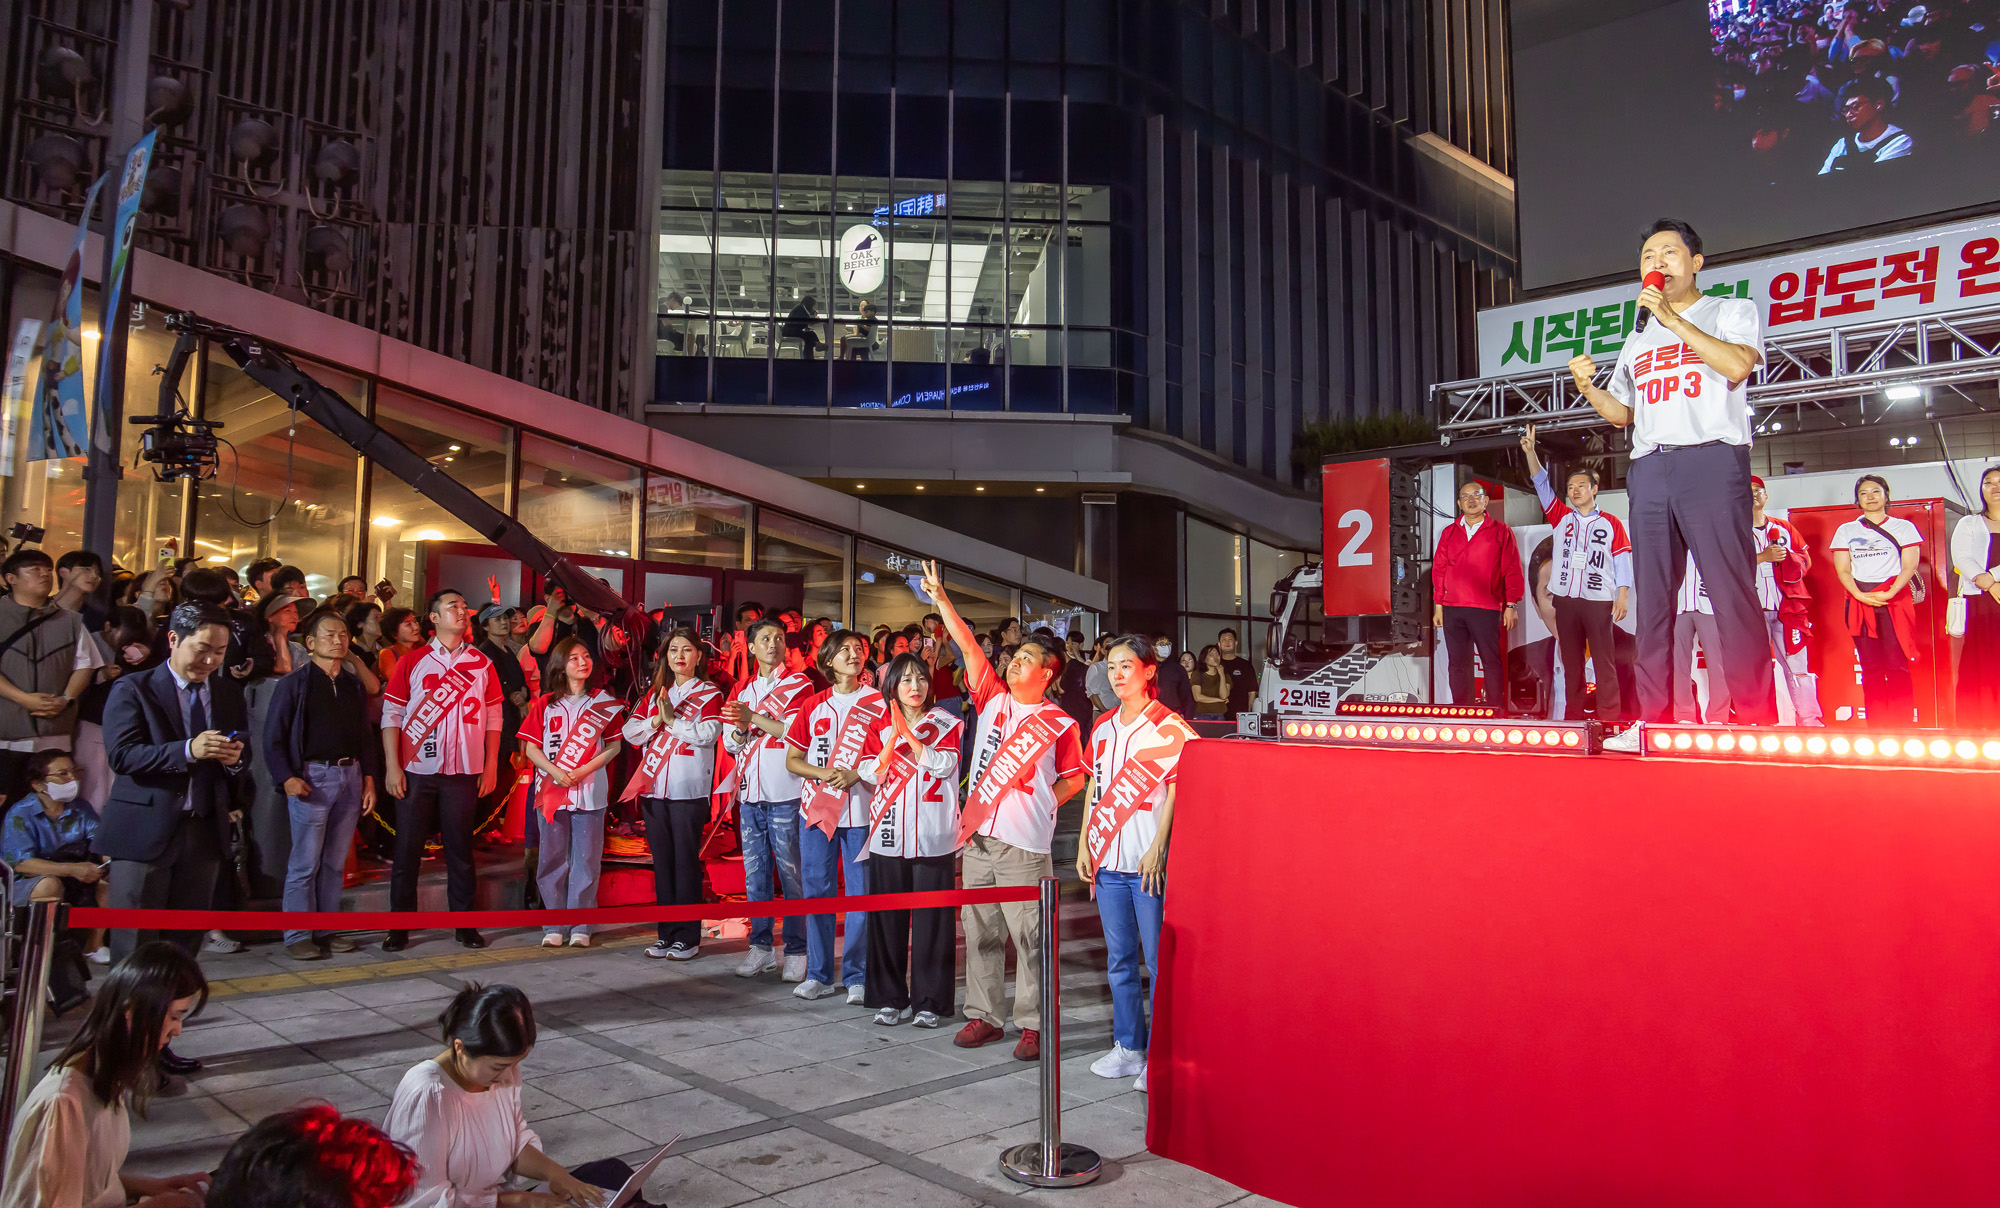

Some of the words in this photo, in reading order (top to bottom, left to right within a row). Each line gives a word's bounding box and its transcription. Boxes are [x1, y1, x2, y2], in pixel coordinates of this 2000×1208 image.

[844, 257, 881, 270] BERRY
[851, 250, 873, 261] OAK
[1501, 299, 1638, 367] 시작된
[1768, 246, 1940, 327] 압도적
[1637, 376, 1680, 406] TOP
[1684, 371, 1702, 398] 3
[1338, 509, 1373, 567] 2
[1565, 523, 1574, 537] 2
[1587, 529, 1608, 591] 오세훈
[453, 649, 488, 683] 2
[405, 682, 459, 746] 하태욱
[462, 697, 481, 725] 2
[555, 722, 597, 776] 오현
[642, 726, 674, 778] 나연
[977, 731, 1042, 806] 최종부
[922, 771, 943, 802] 2
[1088, 776, 1140, 860] 주수현
